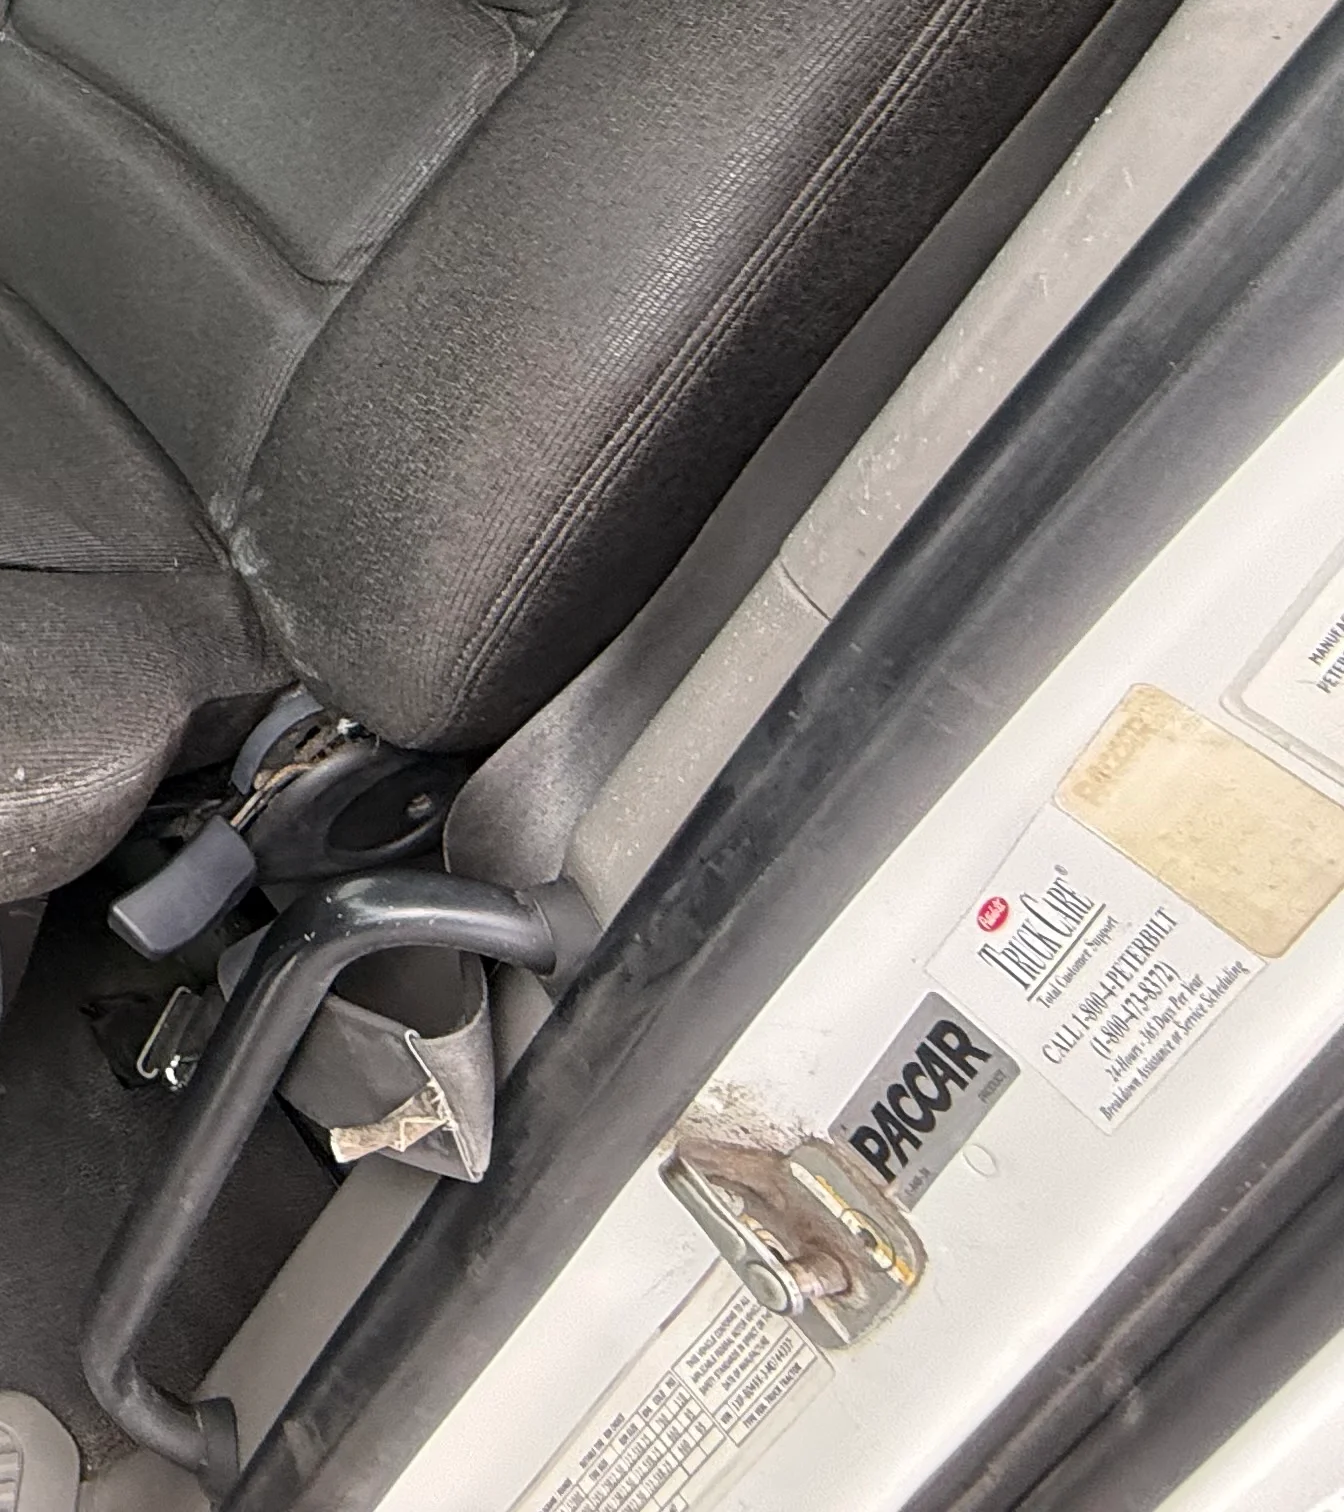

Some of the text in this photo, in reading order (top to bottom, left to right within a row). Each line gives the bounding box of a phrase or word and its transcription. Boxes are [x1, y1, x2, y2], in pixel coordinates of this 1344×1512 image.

[1308, 613, 1344, 666] MANUFA
[977, 918, 1063, 990] TRUCK
[1035, 912, 1122, 1010] Total Customer Support
[1039, 905, 1179, 1067] CALL 1-800-4-PETERBILT
[1087, 955, 1182, 1064] (1-800-473-8372)
[1097, 1071, 1143, 1123] Breakdown
[1133, 1036, 1176, 1084] Assistance
[1172, 997, 1209, 1037] Service
[1197, 954, 1249, 1012] Scheduling
[1136, 1020, 1160, 1044] 365
[1149, 1001, 1178, 1031] Days
[1166, 987, 1190, 1010] Per
[848, 1019, 992, 1184] PACCAR
